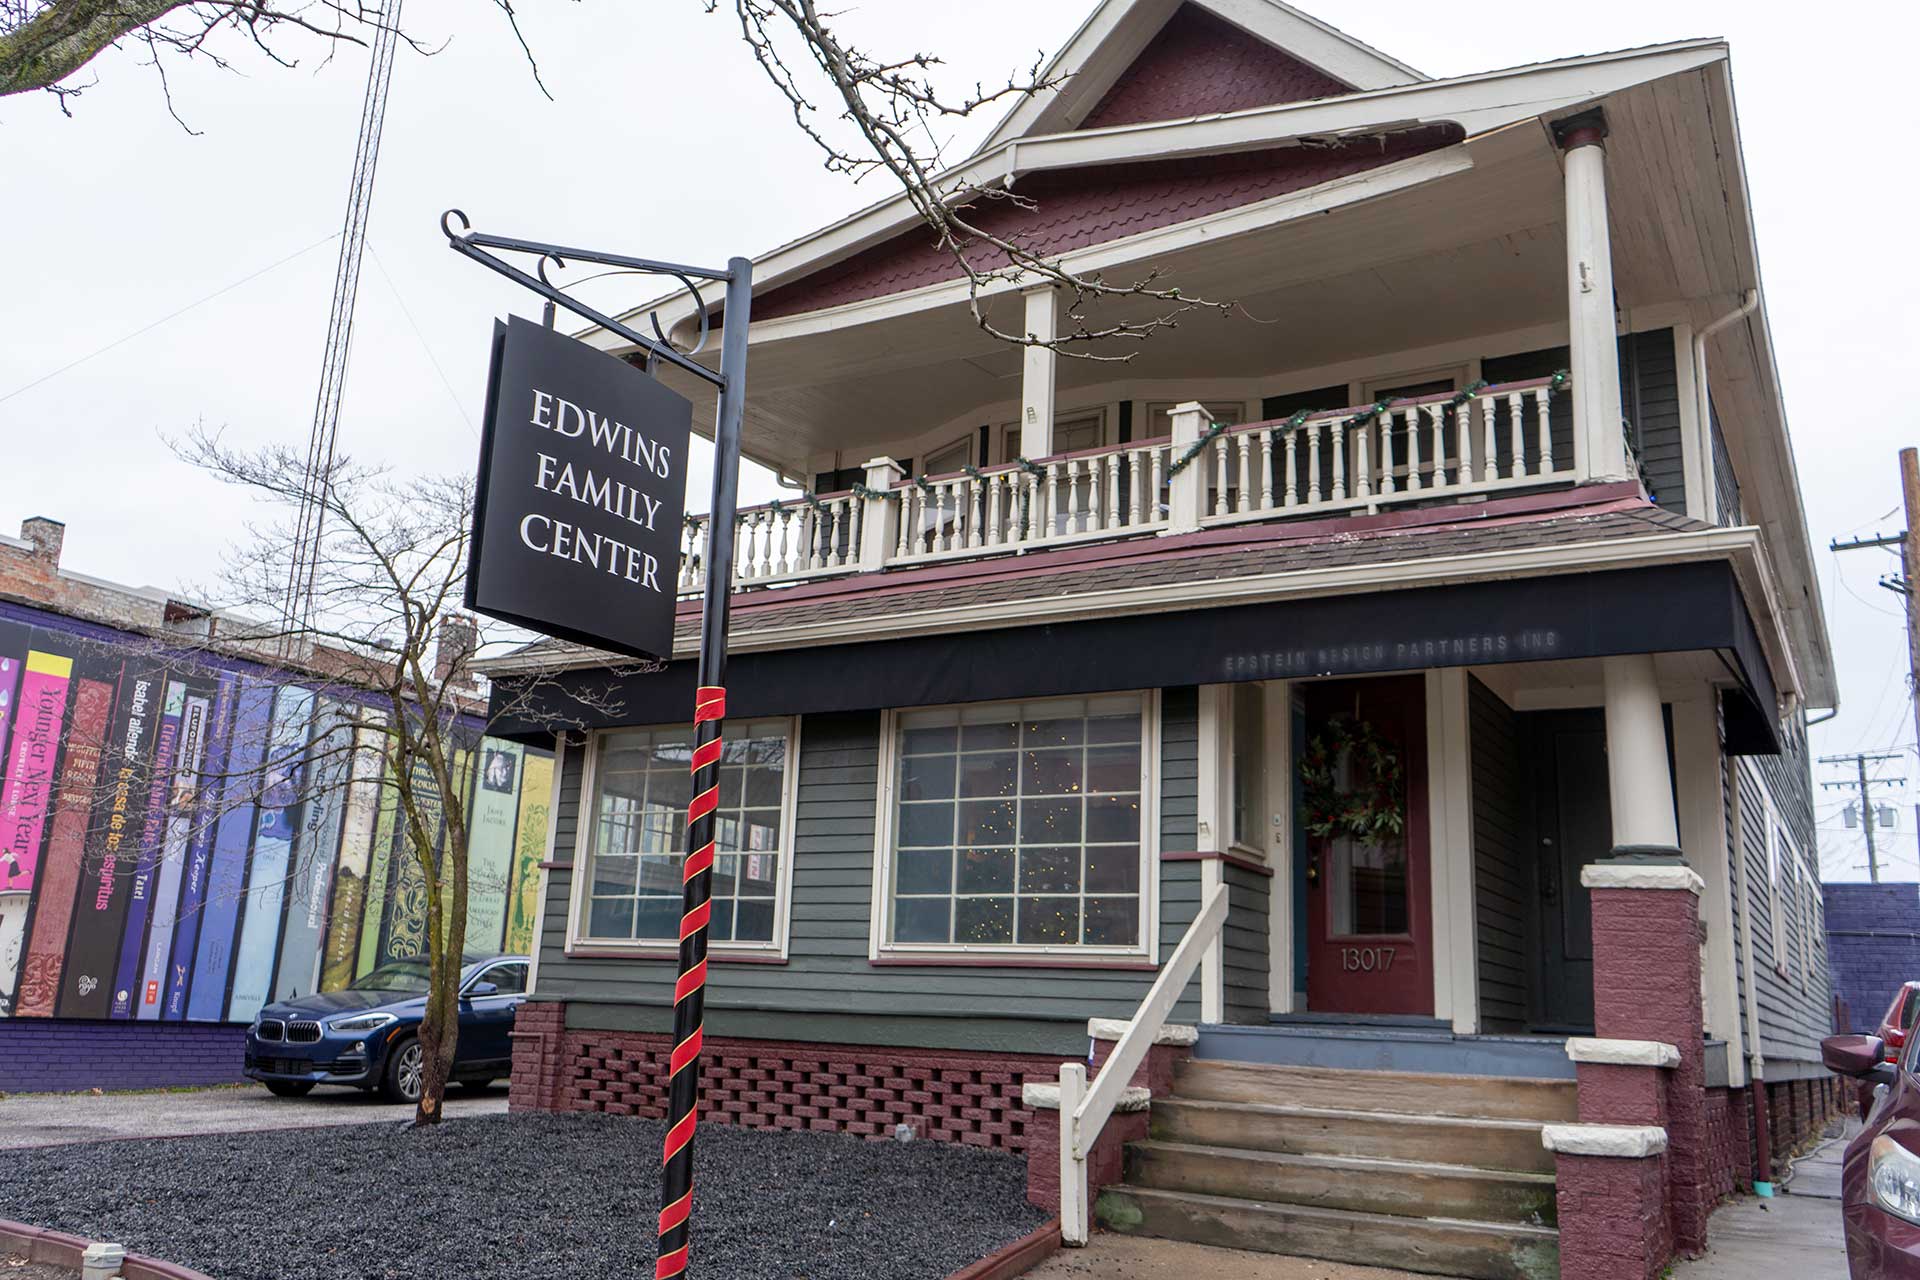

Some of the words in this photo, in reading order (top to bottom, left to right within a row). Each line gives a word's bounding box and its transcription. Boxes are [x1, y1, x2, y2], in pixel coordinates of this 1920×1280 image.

[530, 389, 671, 479] EDWINS
[534, 452, 663, 531] FAMILY
[519, 513, 662, 593] CENTER
[1224, 651, 1306, 671] EPSTEIN
[1397, 635, 1507, 657] PARTNERS
[131, 680, 151, 717] isabel
[28, 688, 62, 763] Younger
[124, 717, 144, 761] allende
[20, 766, 48, 807] Next
[14, 813, 41, 854] Year
[110, 813, 127, 831] de
[95, 854, 118, 911] espíritus
[133, 875, 149, 900] Taxel
[191, 851, 206, 894] Keeper
[307, 862, 328, 929] Professional
[1341, 947, 1395, 971] 13017
